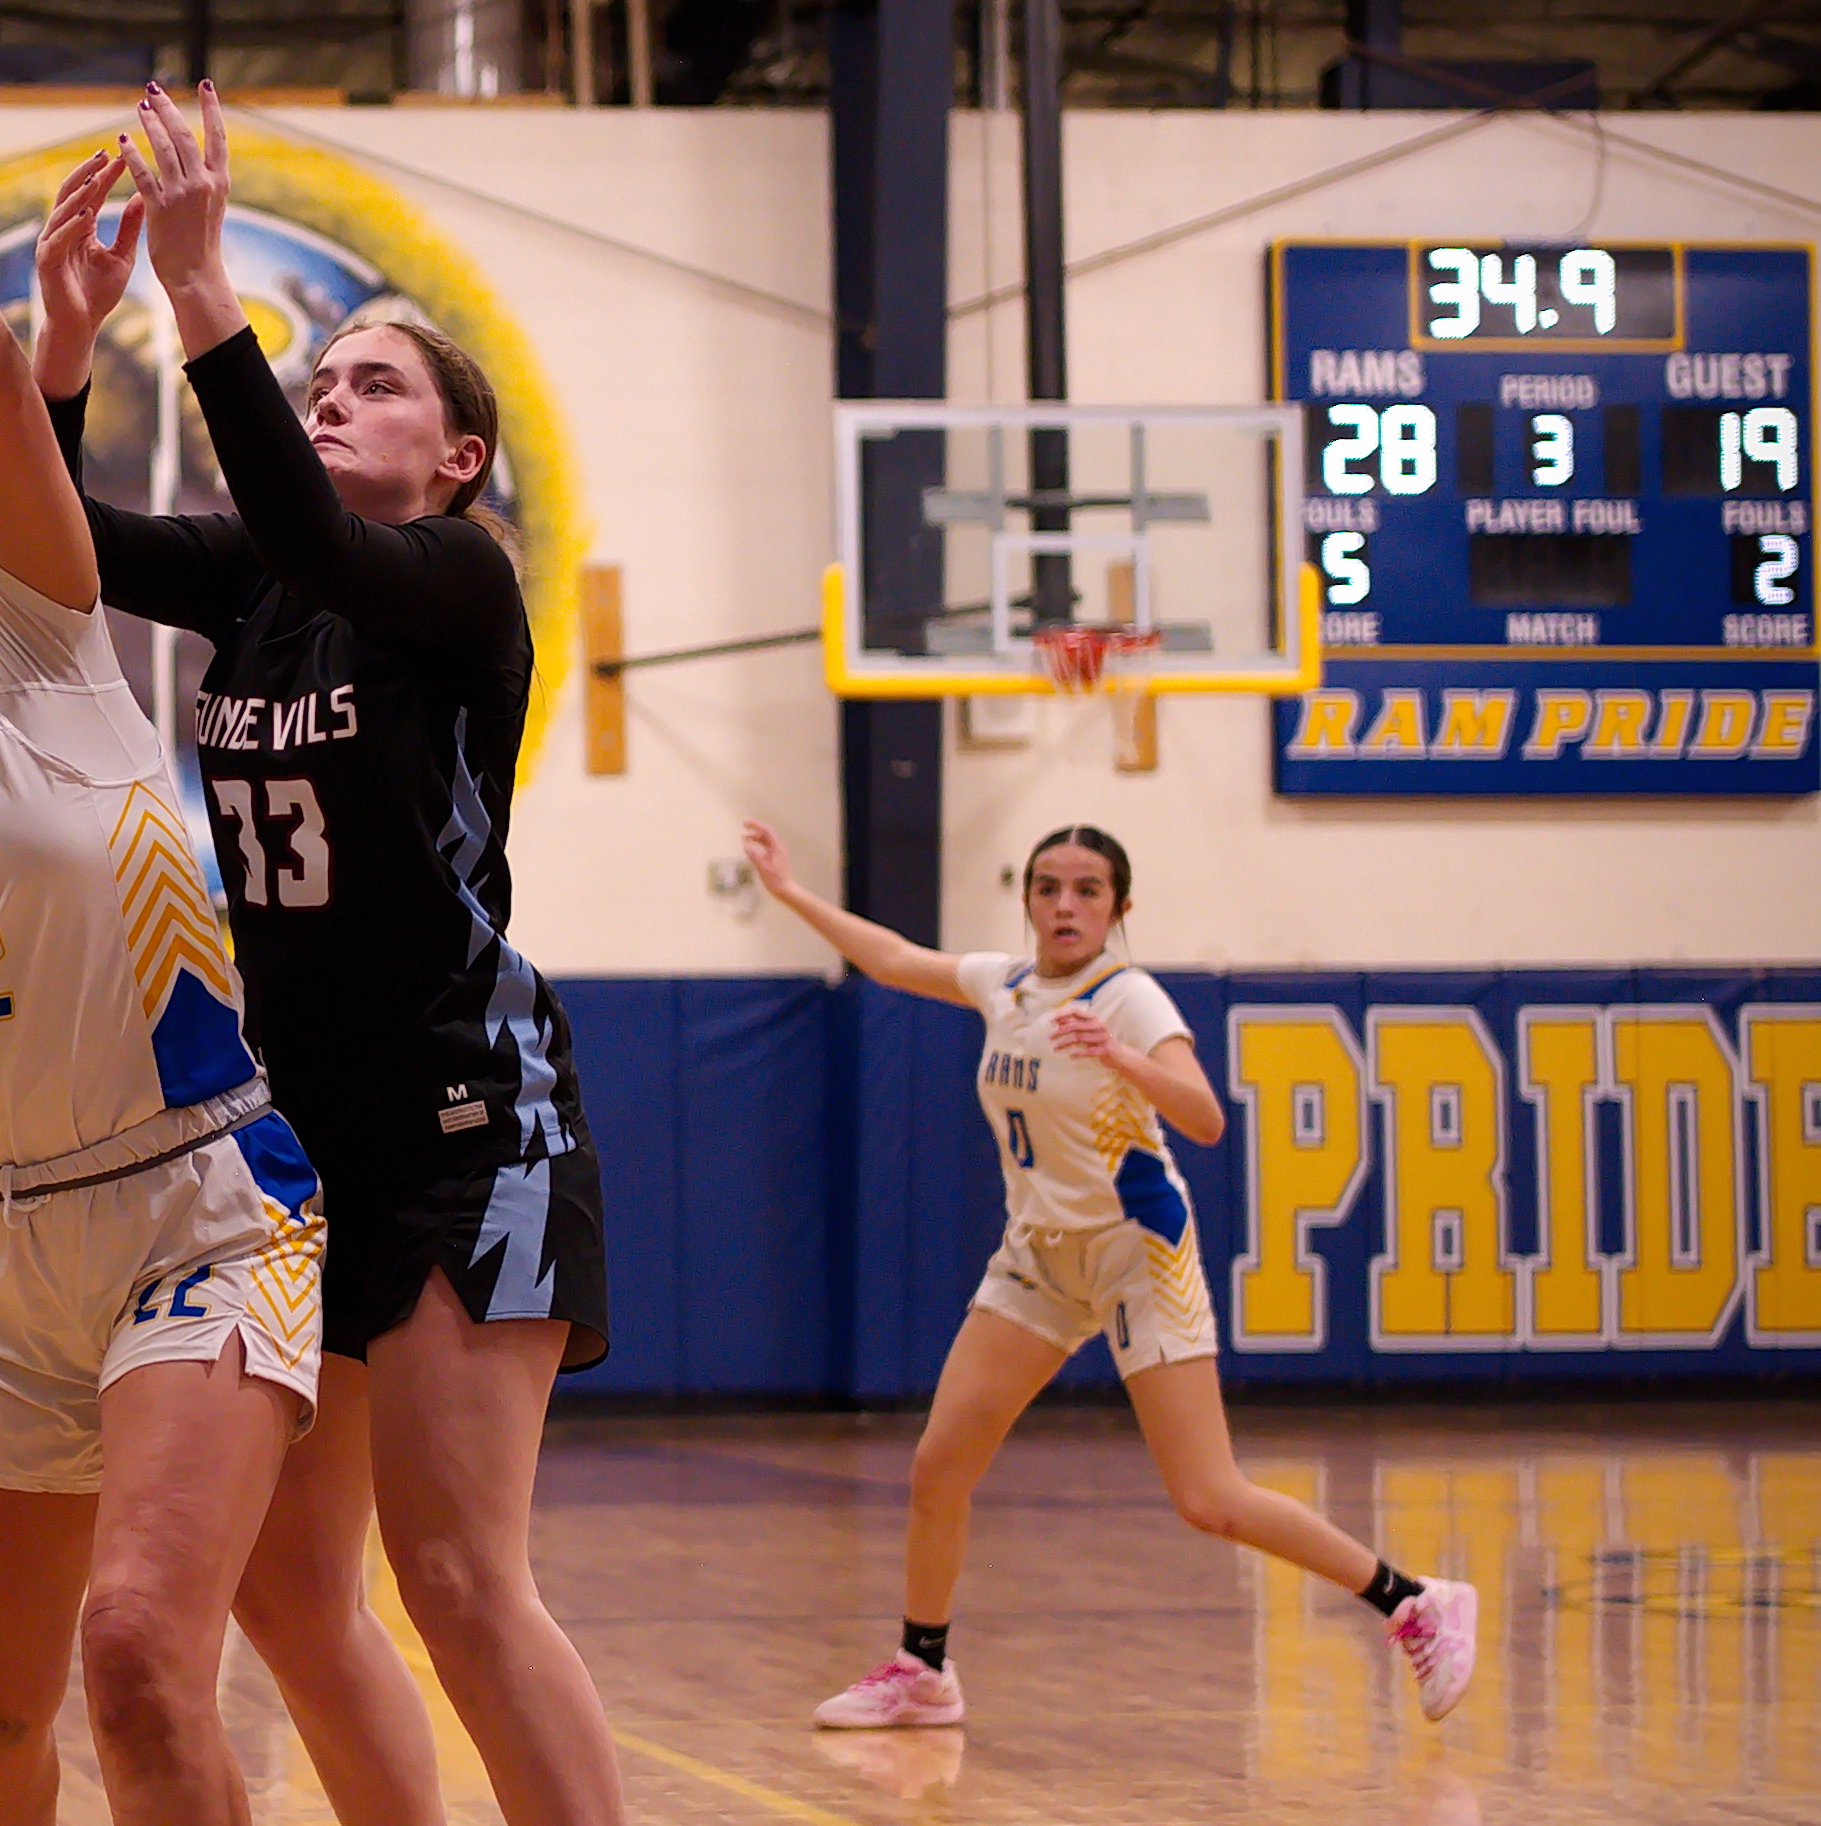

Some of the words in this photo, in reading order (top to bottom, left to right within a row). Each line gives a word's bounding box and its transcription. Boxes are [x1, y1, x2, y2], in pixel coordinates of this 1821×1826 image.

[1428, 247, 1616, 338] 34.9
[1310, 350, 1424, 397] RAMS
[1500, 374, 1598, 408] PERIOD
[1666, 353, 1791, 398] GUEST
[1322, 403, 1437, 495] 28
[1531, 414, 1574, 486] 3
[1719, 407, 1798, 492] 19
[1305, 497, 1380, 534] OULS
[1465, 498, 1567, 534] PLAYER
[1572, 498, 1642, 534] FOUL
[1721, 499, 1809, 534] FOULS
[1321, 531, 1370, 605] 5
[1754, 534, 1799, 605] 2
[1321, 612, 1383, 646] ORE
[1505, 612, 1600, 646] MATCH
[1721, 613, 1814, 647] SCORE
[1287, 688, 1515, 760] RAM
[1522, 688, 1814, 760] PRIDE
[446, 1083, 469, 1102] M
[1006, 1108, 1034, 1169] 0
[1228, 1005, 1821, 1352] PRIDE
